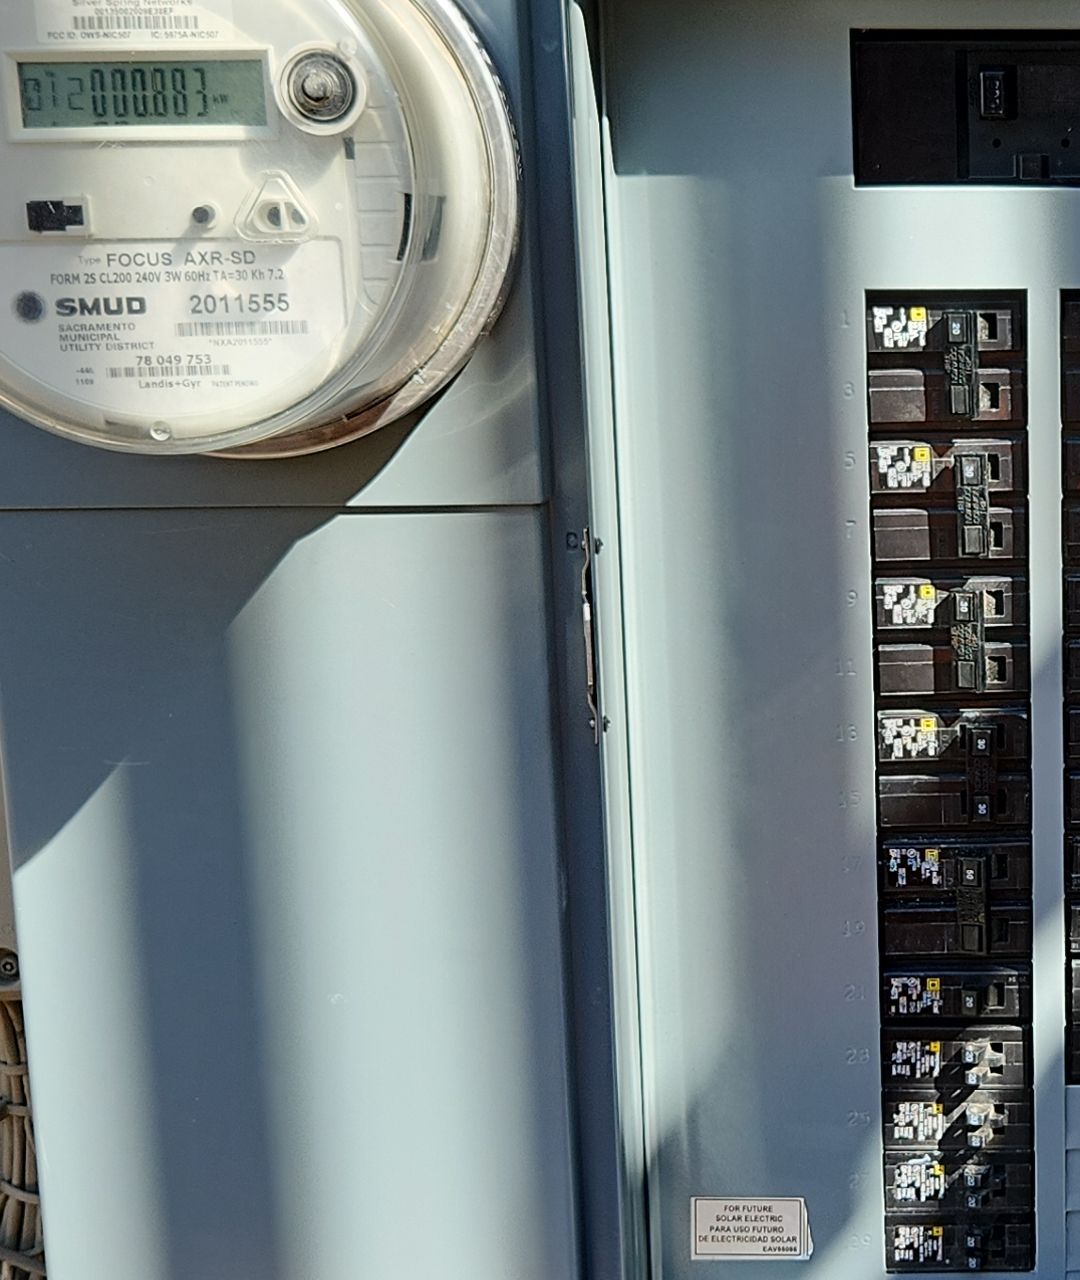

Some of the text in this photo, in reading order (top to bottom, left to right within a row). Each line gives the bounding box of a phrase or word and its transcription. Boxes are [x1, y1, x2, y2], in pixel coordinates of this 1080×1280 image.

[78, 251, 256, 267] Type FOCUS AXR-SD
[50, 269, 284, 284] FORM 2S CL200 240V 3W 60Hz TA=30 Kh 7.2
[55, 293, 290, 316] SMUD 2011555
[58, 323, 136, 333] SACRAMENTO
[59, 332, 120, 342] MUNICIPAL
[60, 341, 155, 352] UTILITY DISTRICT
[136, 354, 212, 366] 78 049 753
[138, 379, 201, 390] Landis+Gyr
